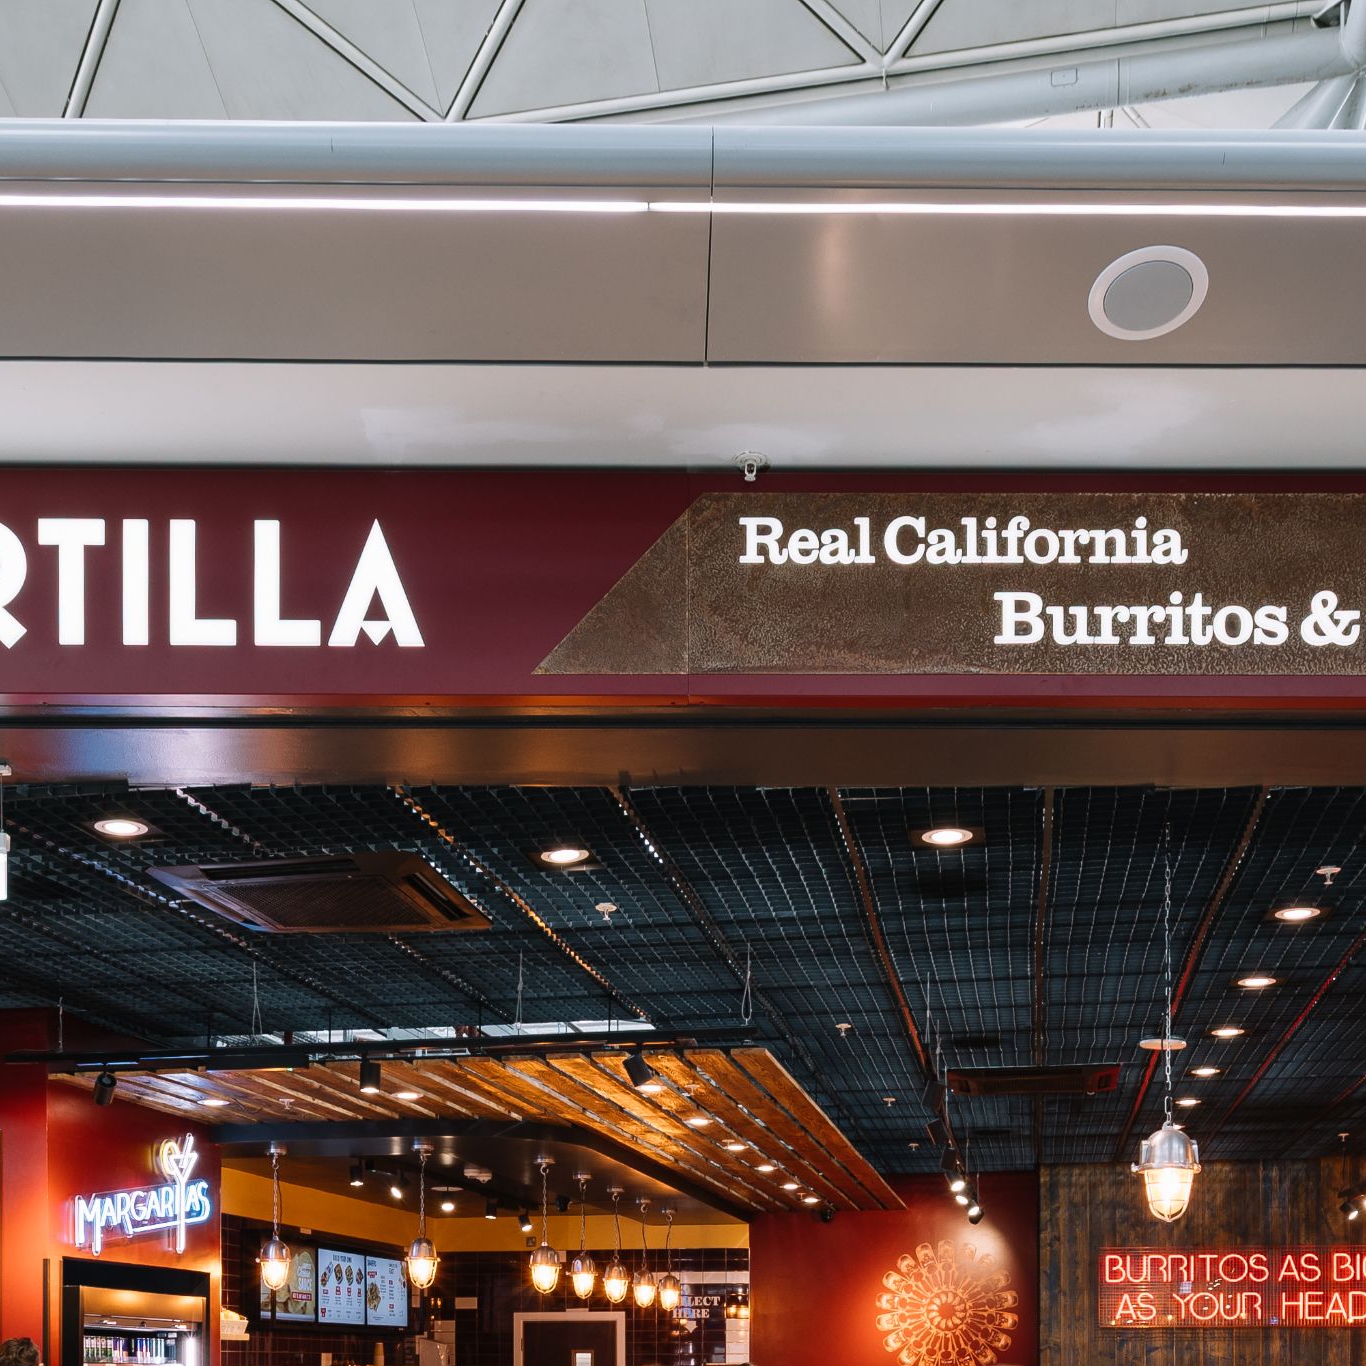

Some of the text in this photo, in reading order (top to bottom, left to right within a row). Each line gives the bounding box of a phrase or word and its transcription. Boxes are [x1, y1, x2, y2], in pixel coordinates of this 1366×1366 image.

[738, 515, 1189, 565] Real California
[993, 591, 1288, 647] Burritos
[1301, 592, 1362, 648] &
[1105, 1252, 1269, 1283] BURRITOS
[1278, 1252, 1321, 1283] AS
[1115, 1290, 1156, 1321] AS
[1172, 1291, 1262, 1321] YOUR
